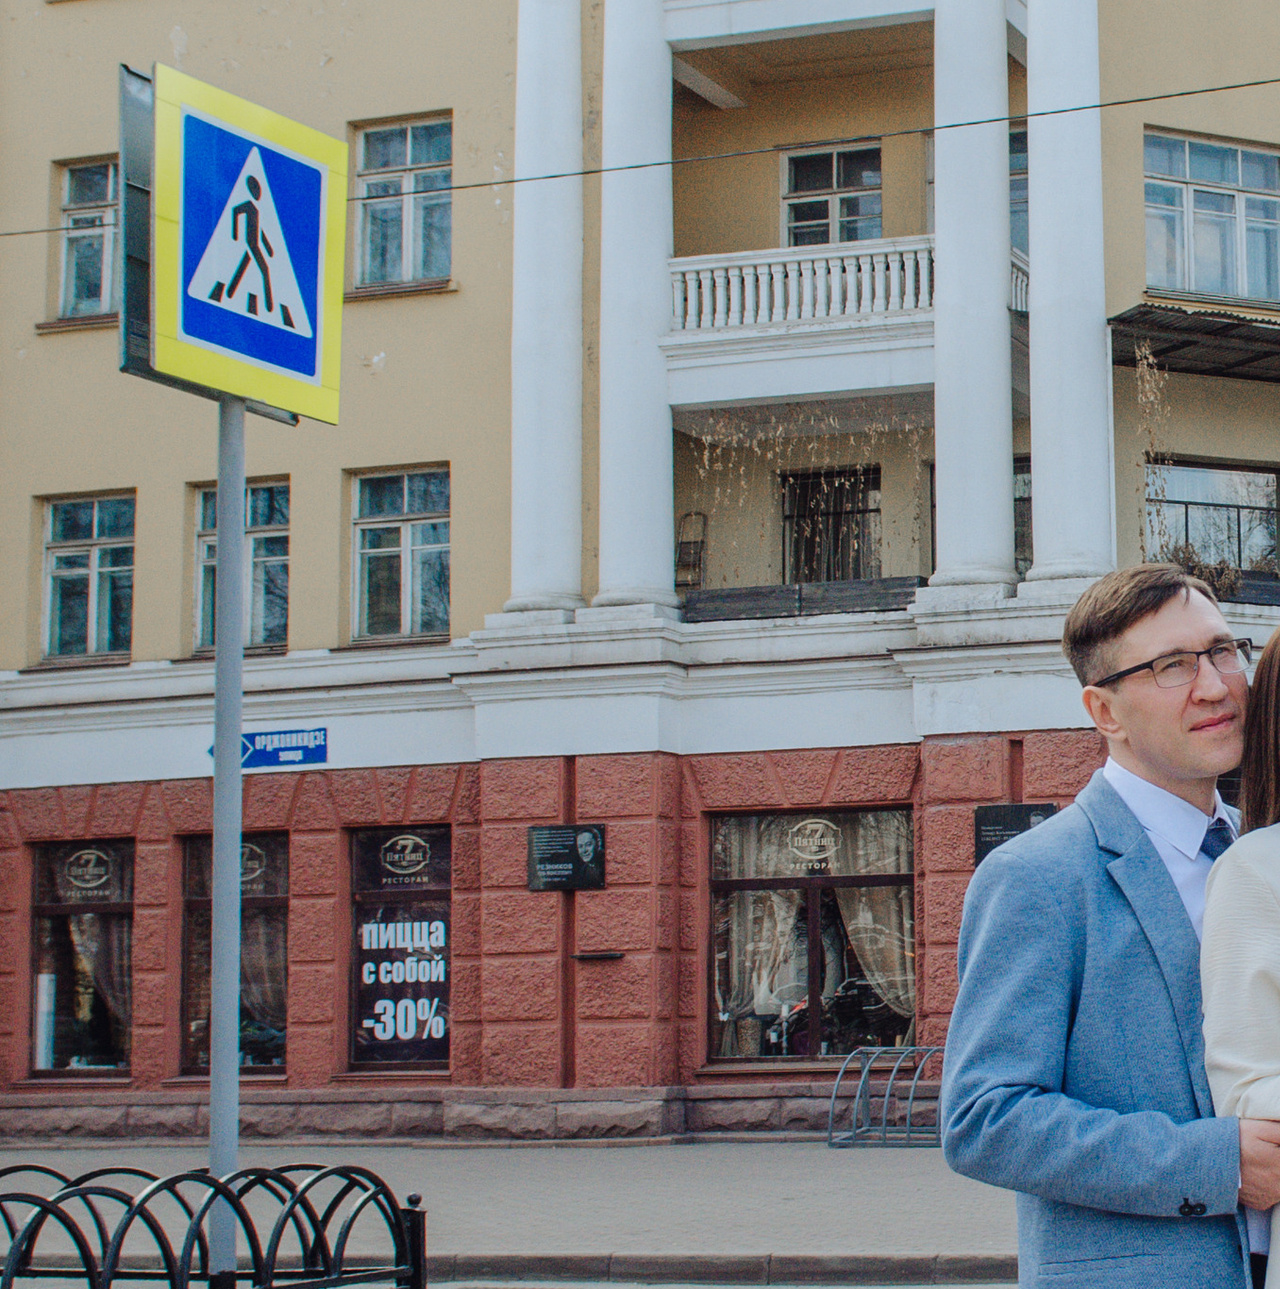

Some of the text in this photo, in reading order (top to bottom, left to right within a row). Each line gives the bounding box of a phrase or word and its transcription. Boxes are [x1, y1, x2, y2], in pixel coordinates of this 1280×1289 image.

[381, 876, 429, 884] РЕСТОРАН
[790, 862, 840, 870] РЕСТОРАН
[362, 920, 446, 952] пицца
[362, 954, 446, 984] с собой
[362, 997, 446, 1041] -30%
